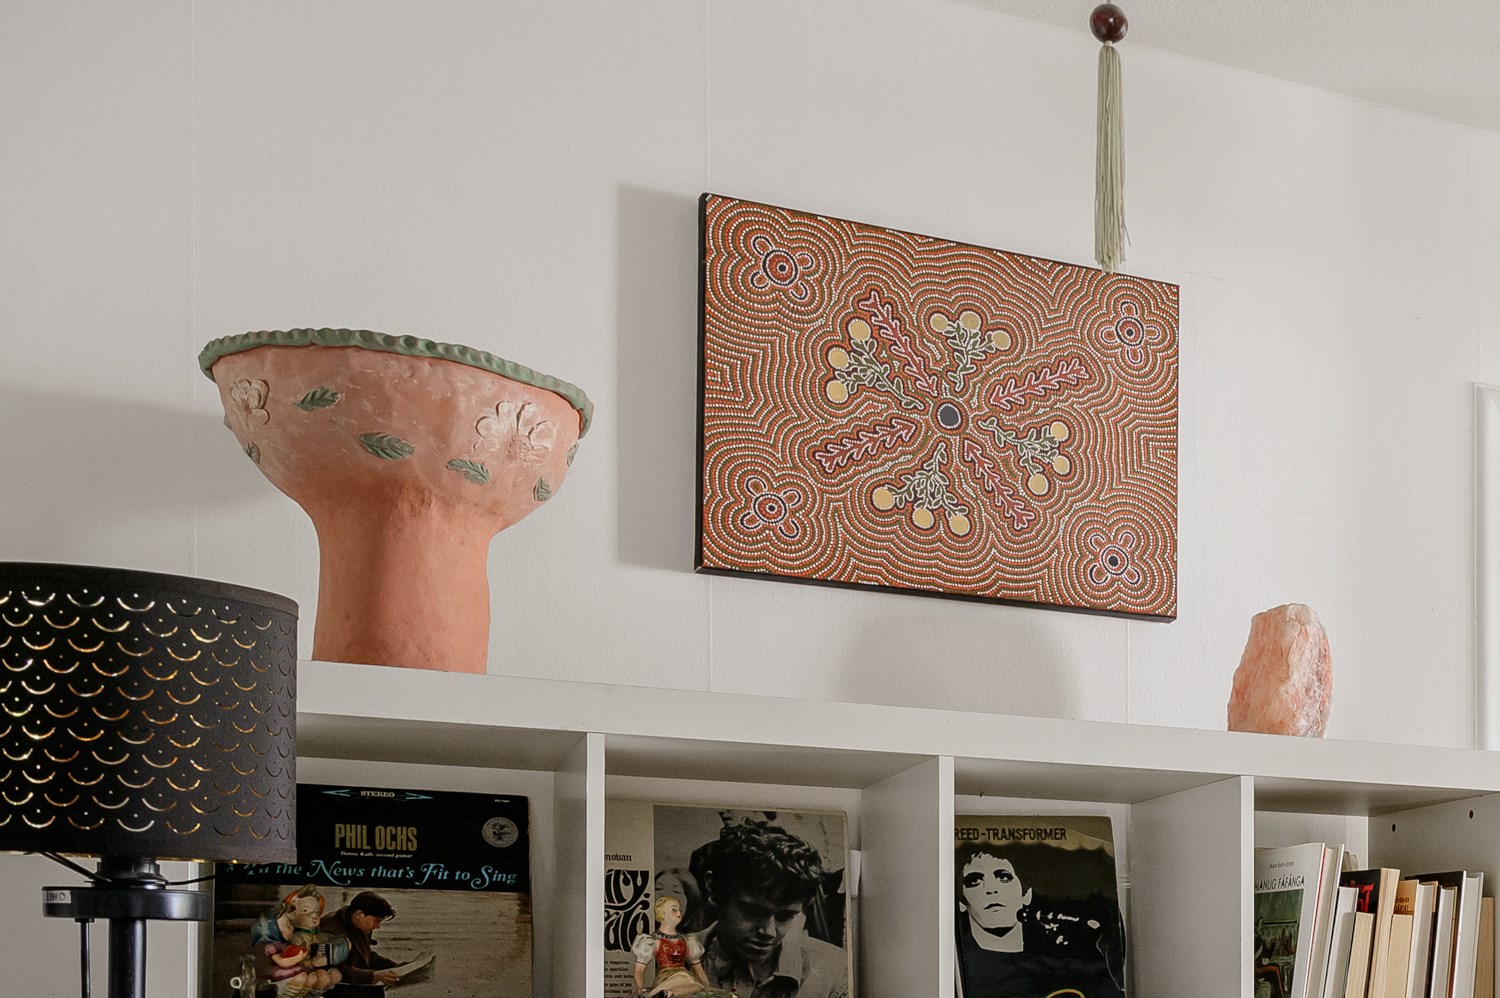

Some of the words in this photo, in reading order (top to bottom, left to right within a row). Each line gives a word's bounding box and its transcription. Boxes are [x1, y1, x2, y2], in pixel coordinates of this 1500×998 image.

[360, 790, 395, 798] STEREO
[334, 823, 371, 850] PHIL
[375, 825, 418, 851] OCHS
[604, 853, 632, 862] novan
[276, 863, 302, 875] the
[306, 859, 365, 886] News
[371, 864, 415, 879] that's
[414, 862, 449, 886] Fit
[455, 868, 471, 881] to
[470, 865, 518, 889] Sing
